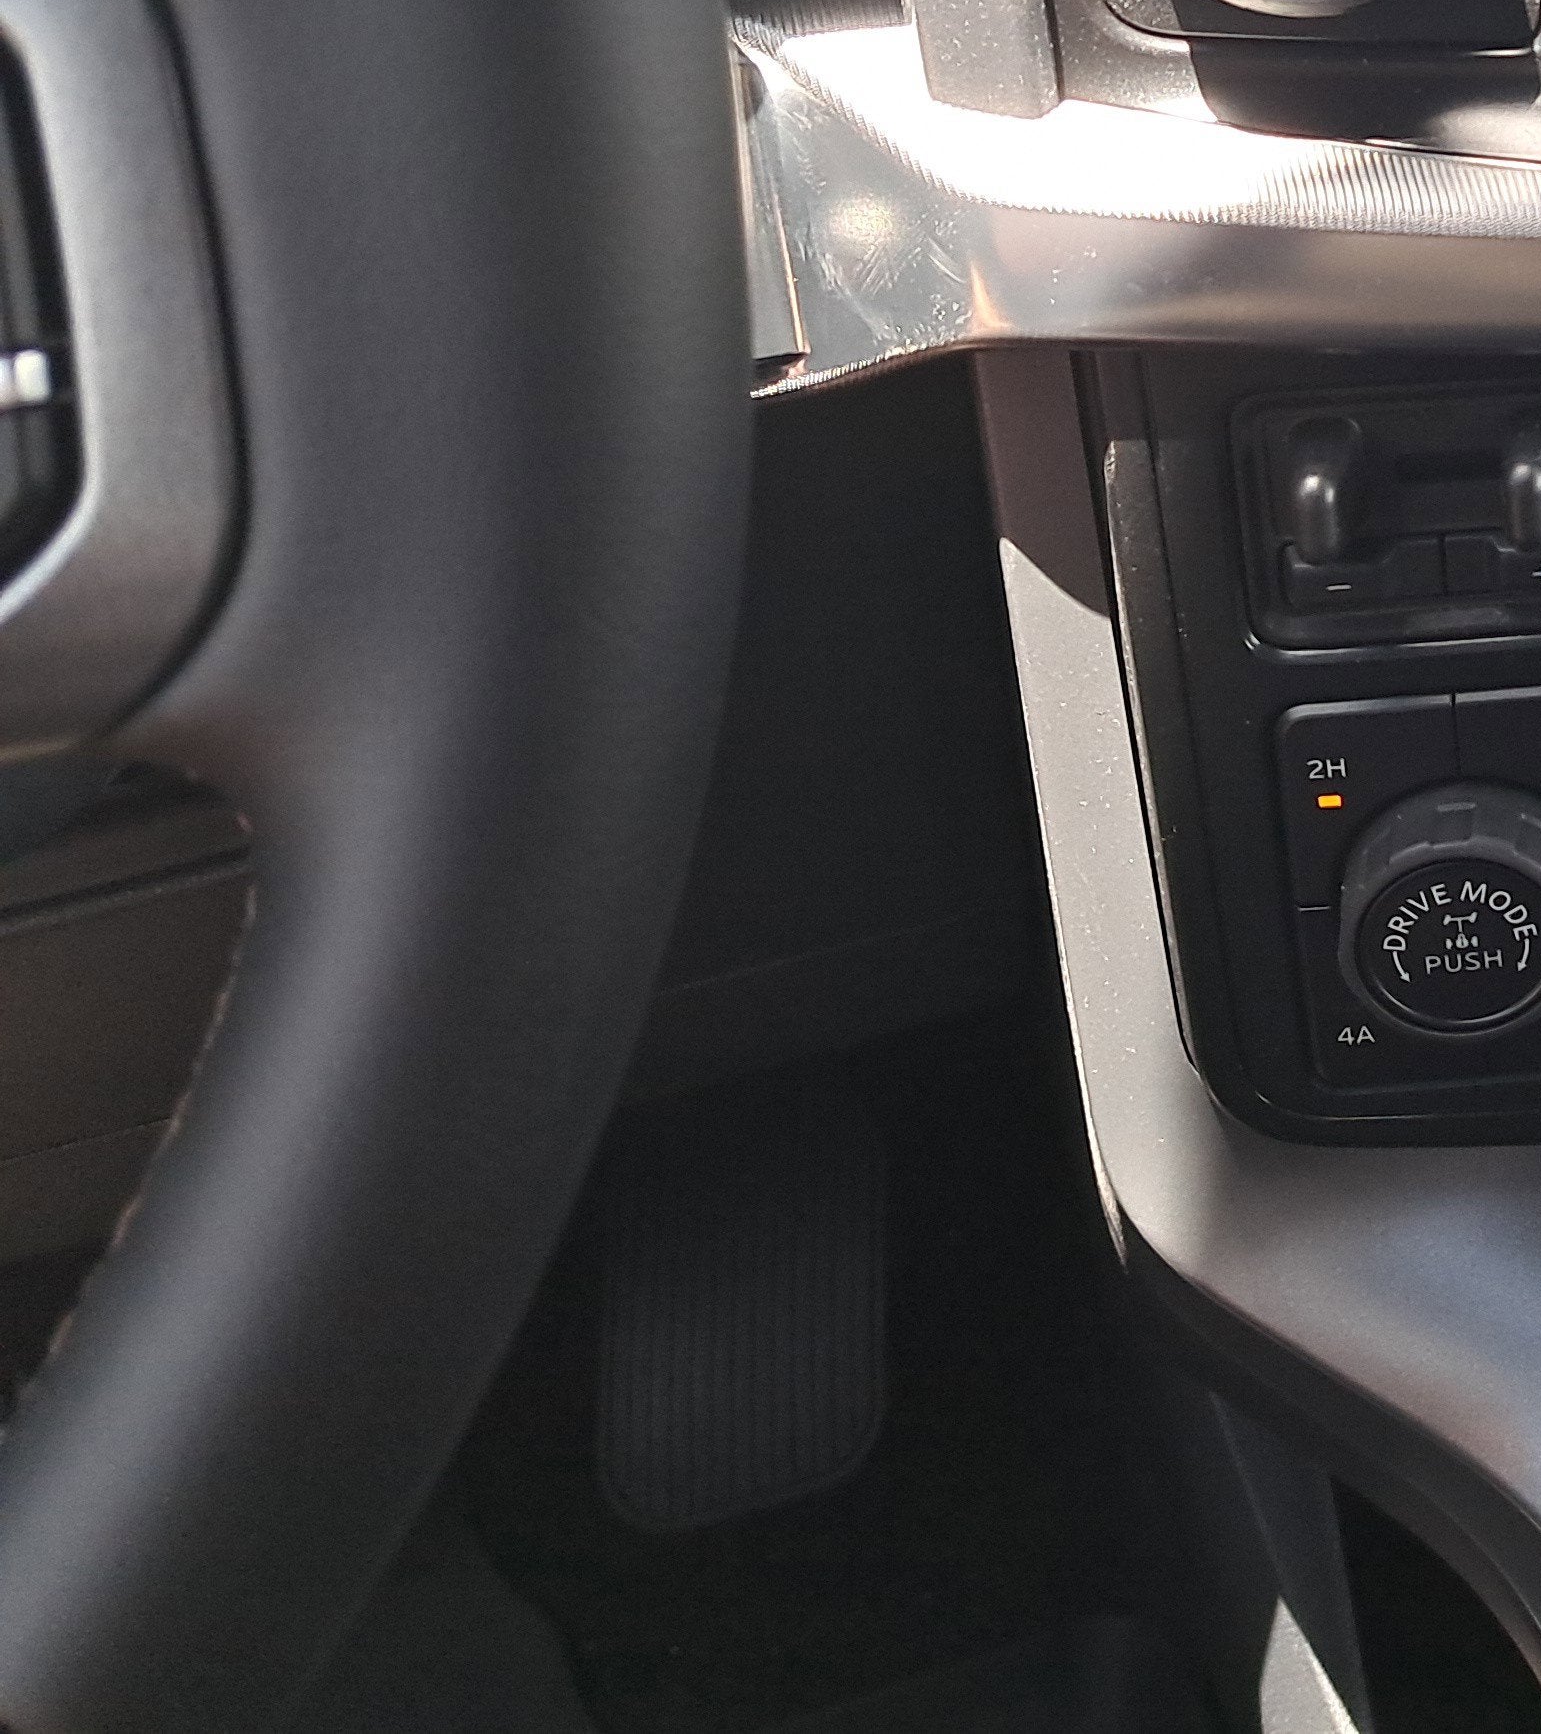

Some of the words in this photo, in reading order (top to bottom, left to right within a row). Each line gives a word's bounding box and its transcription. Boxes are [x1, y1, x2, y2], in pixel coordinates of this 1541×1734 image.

[1306, 758, 1347, 781] 2H
[1383, 883, 1452, 952] DRIVE
[1459, 880, 1538, 942] MODE
[1424, 950, 1503, 975] PUSH
[1337, 1026, 1376, 1045] 4A
